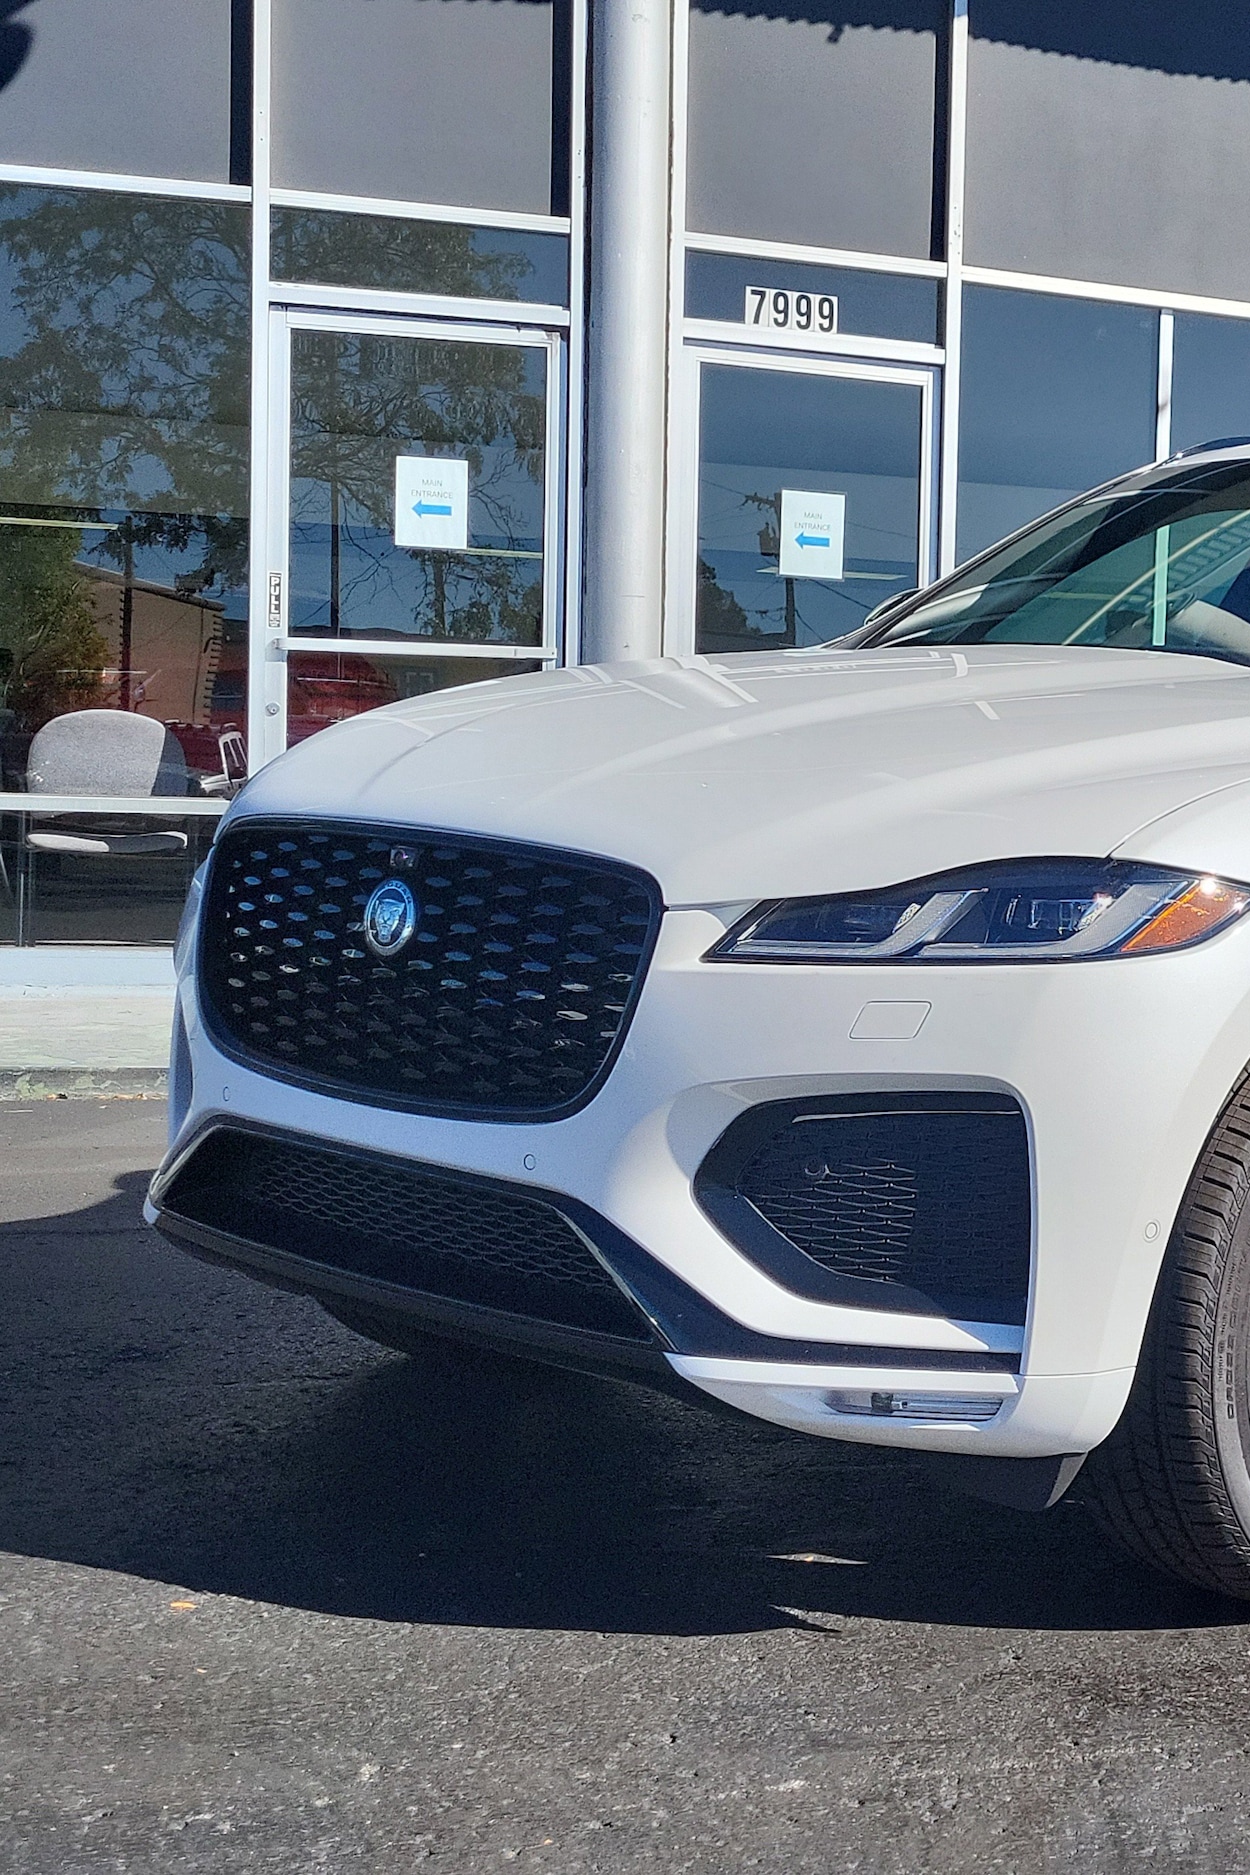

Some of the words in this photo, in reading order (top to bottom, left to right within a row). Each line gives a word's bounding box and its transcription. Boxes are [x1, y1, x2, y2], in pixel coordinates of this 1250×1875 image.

[750, 289, 834, 333] 7999
[421, 479, 443, 487] MAIN
[411, 489, 453, 499] ENTRANCE
[804, 511, 823, 520] MAIN
[794, 522, 831, 532] ENTRANCE
[270, 576, 280, 613] PULL
